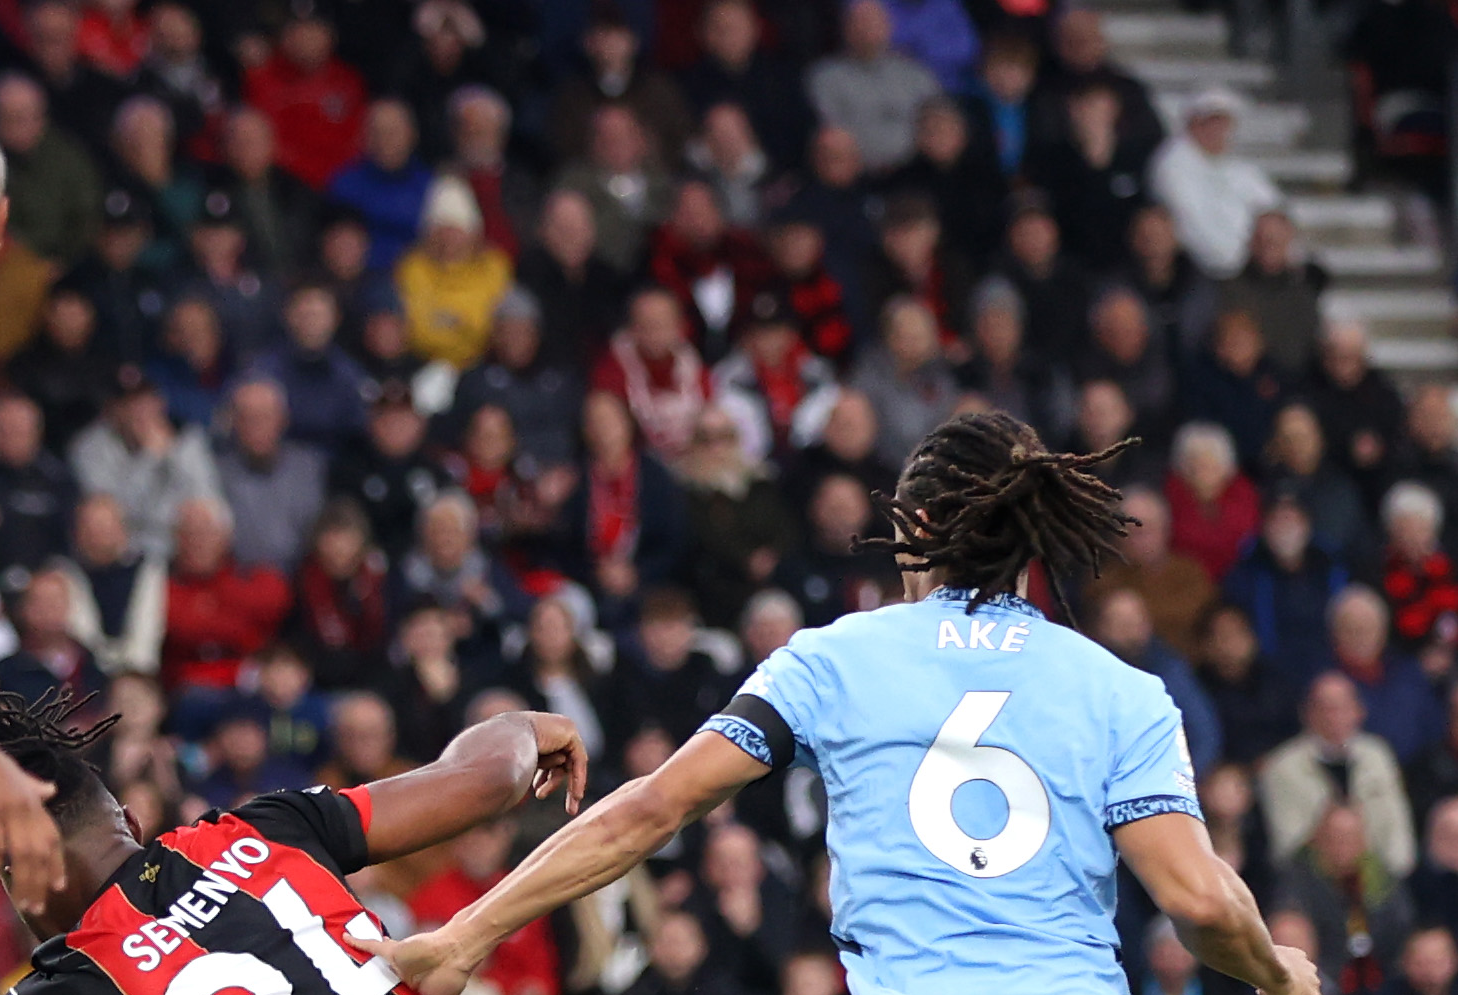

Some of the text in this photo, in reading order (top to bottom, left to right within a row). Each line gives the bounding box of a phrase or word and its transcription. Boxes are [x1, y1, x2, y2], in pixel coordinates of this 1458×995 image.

[937, 621, 1033, 653] AKÉ
[908, 691, 1051, 879] 6
[122, 837, 270, 972] SEMENYO
